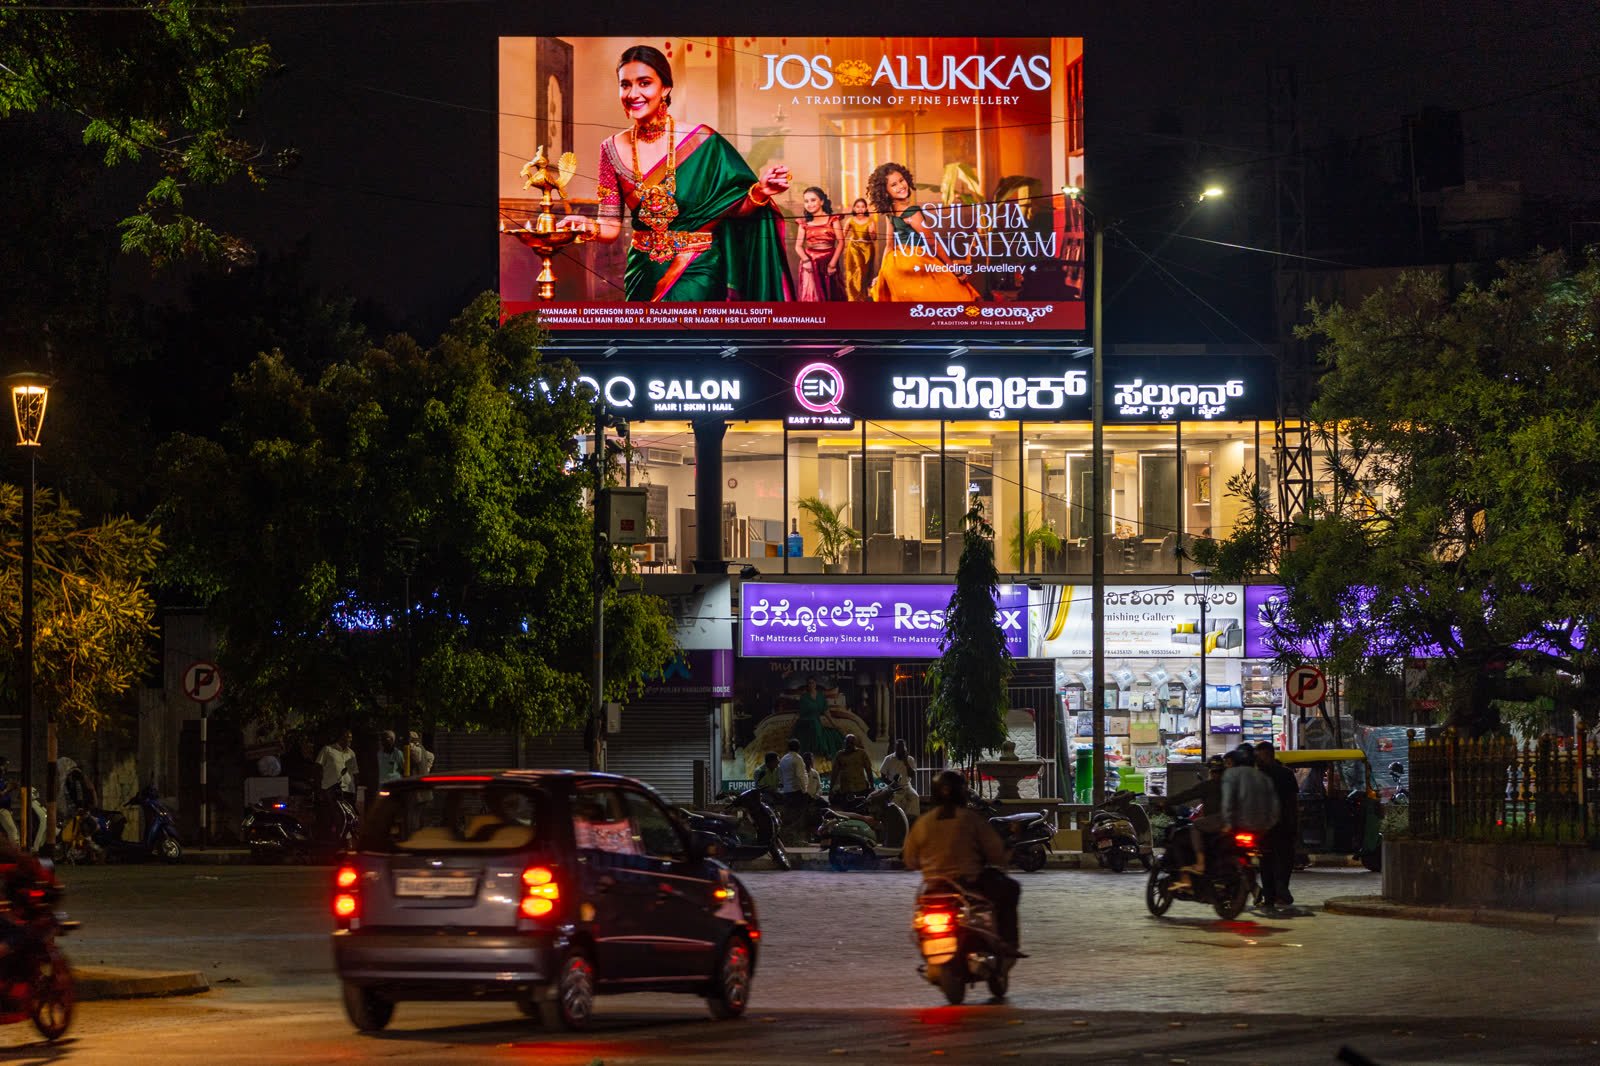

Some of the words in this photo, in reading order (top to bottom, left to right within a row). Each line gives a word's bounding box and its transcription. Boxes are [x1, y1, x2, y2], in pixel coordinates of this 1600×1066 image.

[759, 54, 834, 91] JOS
[871, 54, 1052, 91] ALUKKAS
[791, 96, 800, 105] A
[805, 96, 881, 105] TRADITION
[887, 96, 904, 105] OF
[910, 96, 941, 105] FINE
[946, 96, 1020, 107] JEWELLERY
[920, 202, 1029, 229] SHUBHA
[893, 231, 1057, 257] MANGALYAM
[924, 263, 972, 275] Wedding
[974, 263, 1026, 275] Jewellery
[909, 304, 964, 318] ಜೋಸ್
[648, 380, 740, 400] SALON
[654, 403, 677, 411] HAIR
[683, 403, 705, 411] SKIN
[712, 403, 734, 411] NAIL
[788, 416, 810, 424] EASY
[824, 416, 851, 424] SALON
[1142, 612, 1176, 623] Gallery
[750, 634, 763, 643] The
[766, 634, 801, 643] Mattress
[803, 634, 839, 644] Company
[841, 634, 862, 643] Since
[728, 781, 757, 791] FURNIS
